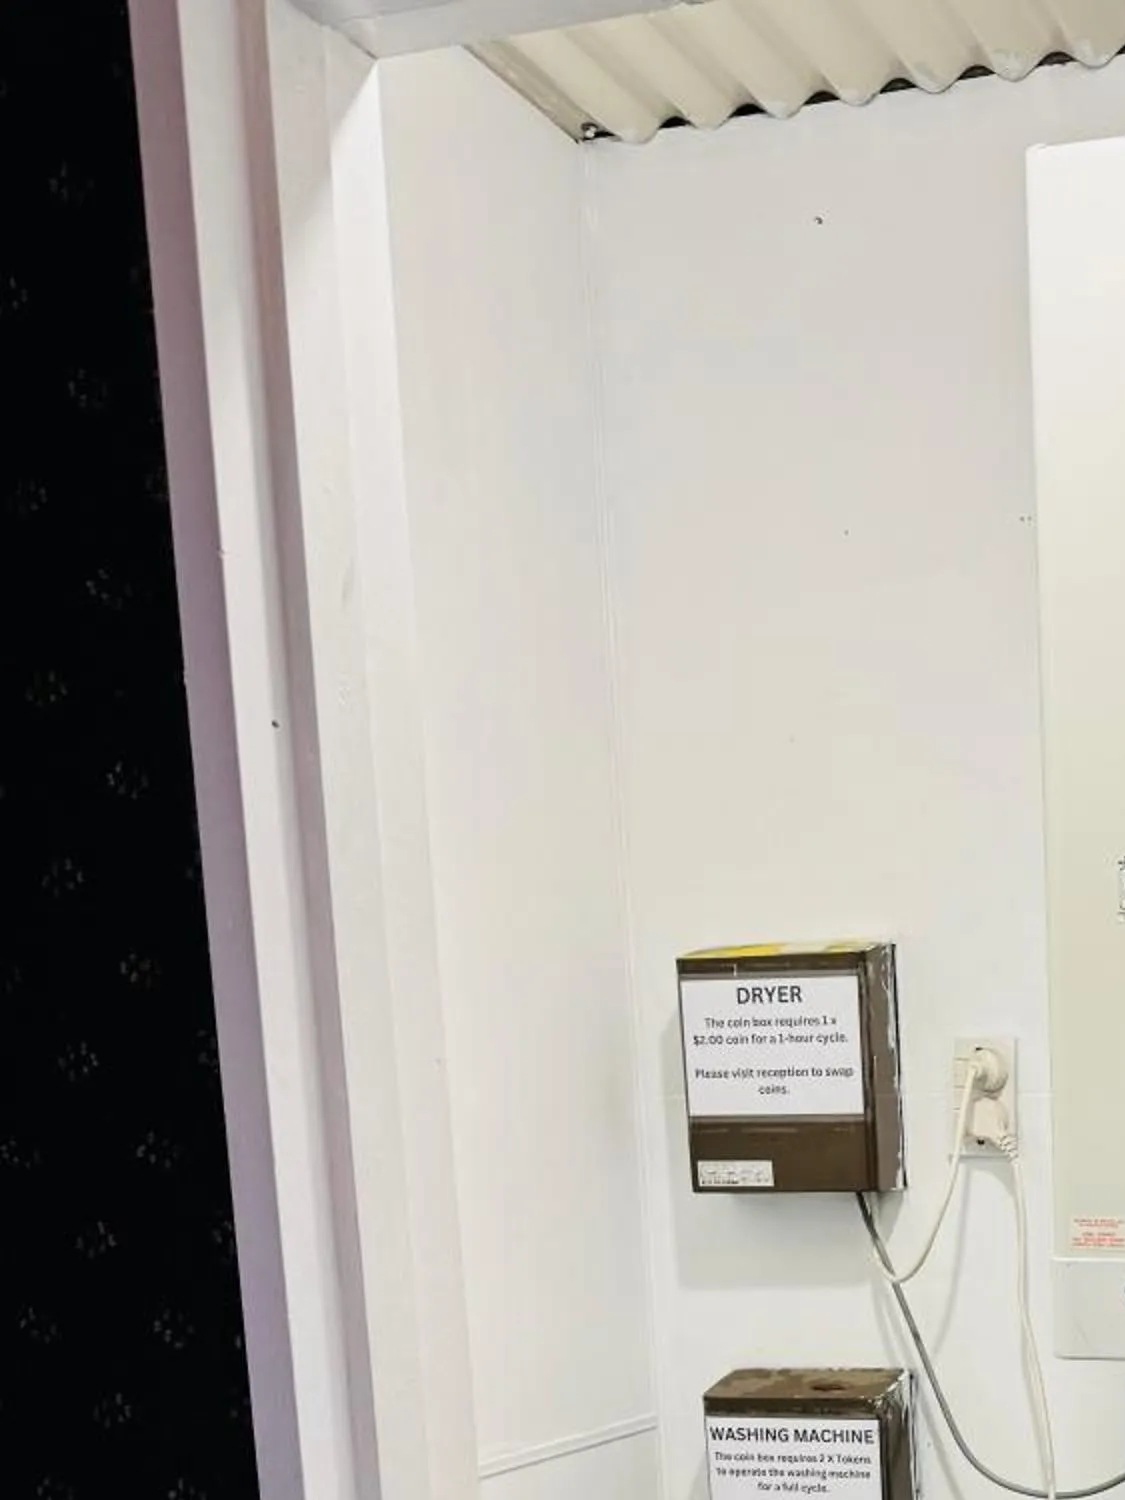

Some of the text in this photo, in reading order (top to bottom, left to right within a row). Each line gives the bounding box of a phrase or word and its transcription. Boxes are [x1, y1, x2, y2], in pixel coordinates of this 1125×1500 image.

[736, 985, 803, 1005] DRYER
[704, 1017, 724, 1029] The
[727, 1017, 750, 1028] coin
[753, 1016, 772, 1027] box
[775, 1016, 820, 1029] requires
[822, 1015, 828, 1025] 1
[693, 1032, 848, 1046] $2.00 coin for a 1-hour cycle.
[695, 1066, 854, 1079] Please visit reception to swap
[758, 1084, 790, 1095] coins.
[710, 1426, 875, 1445] WASHING MACHINE
[714, 1451, 732, 1461] The
[734, 1452, 754, 1462] coin
[757, 1453, 775, 1463] box
[777, 1453, 817, 1465] requires
[819, 1454, 825, 1463] 2
[729, 1468, 767, 1478] operate
[769, 1468, 784, 1477] the
[787, 1468, 827, 1480] washing
[828, 1469, 871, 1479] machine
[757, 1481, 771, 1491] for
[782, 1482, 799, 1491] full
[801, 1483, 830, 1494] cycle.
